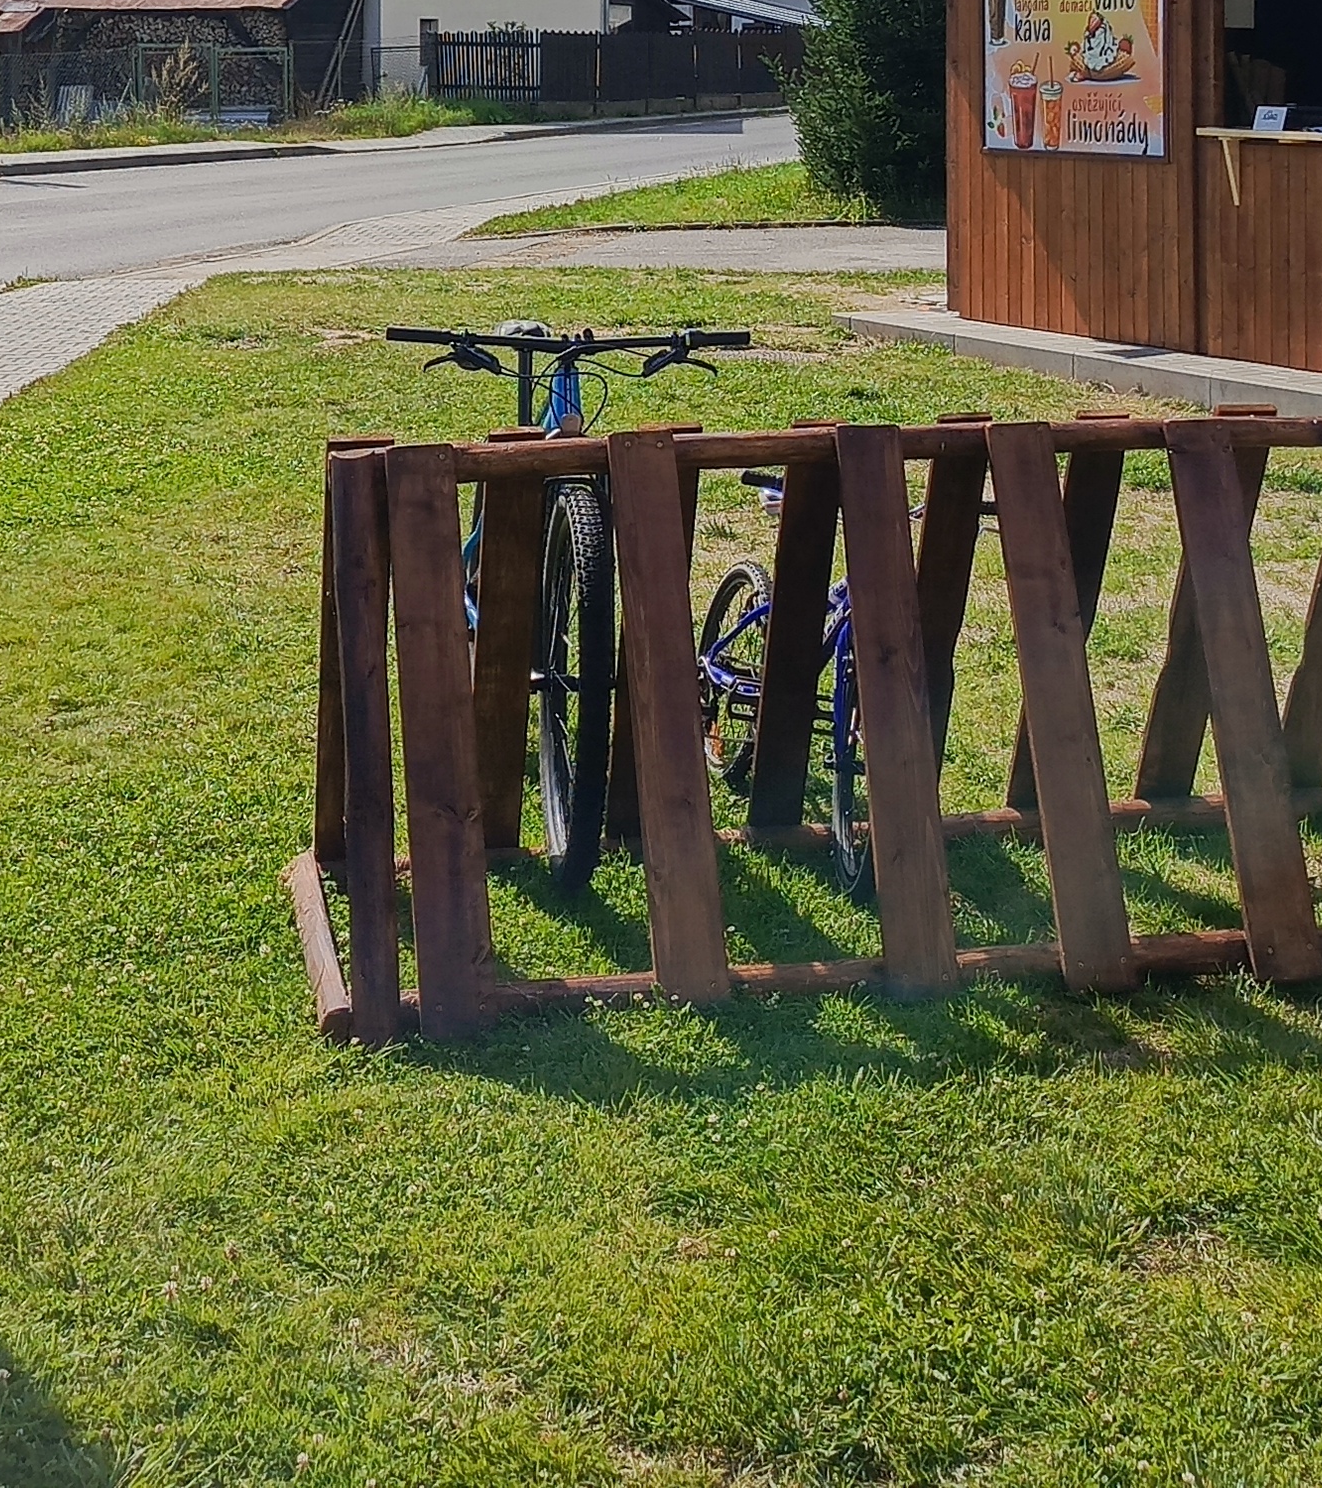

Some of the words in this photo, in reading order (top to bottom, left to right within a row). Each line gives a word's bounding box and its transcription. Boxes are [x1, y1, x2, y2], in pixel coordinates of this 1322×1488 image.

[1014, 11, 1051, 43] káva
[1072, 92, 1123, 119] osvěžující
[1067, 110, 1149, 155] limonády
